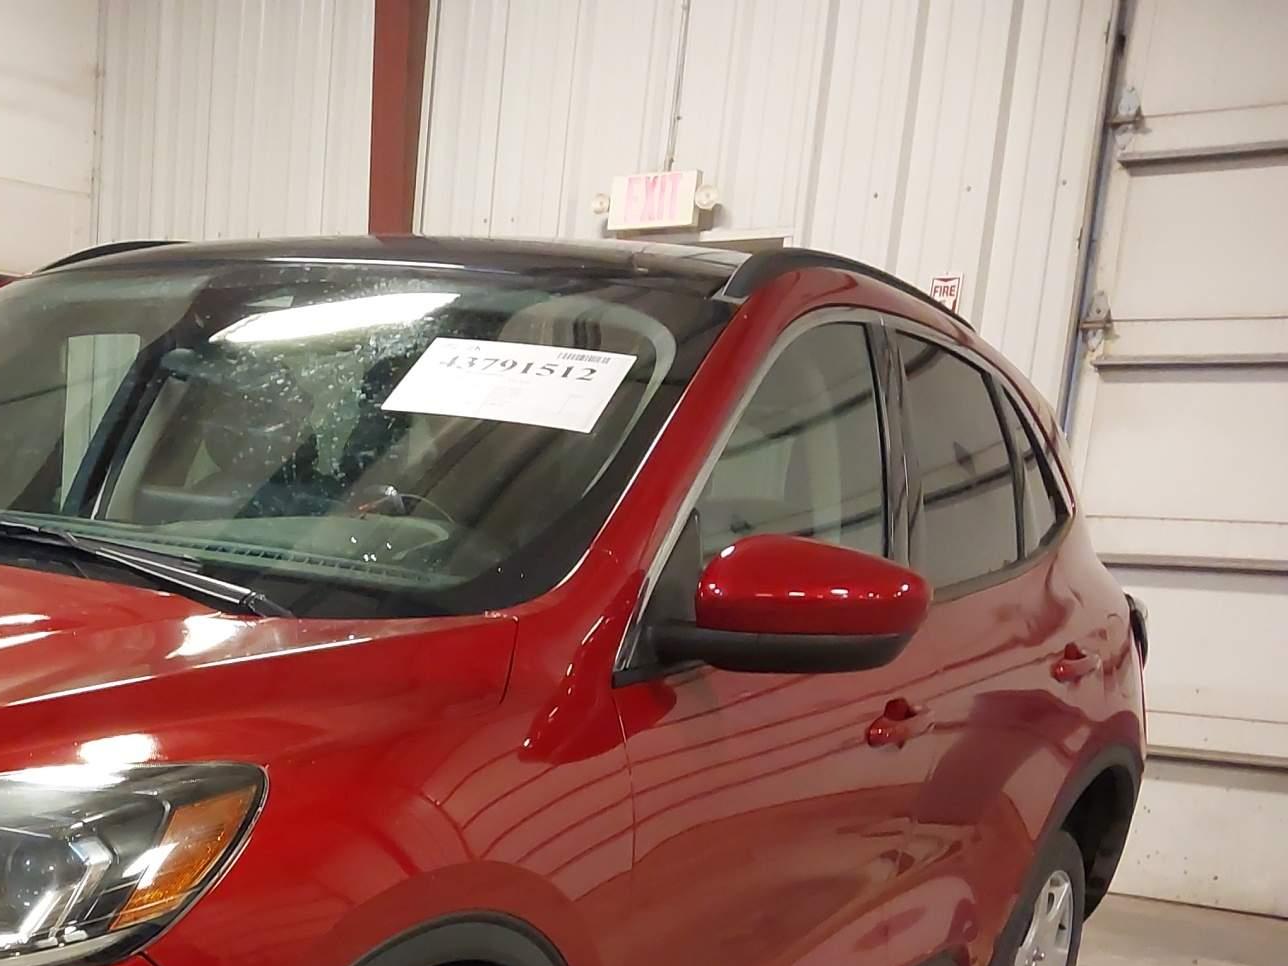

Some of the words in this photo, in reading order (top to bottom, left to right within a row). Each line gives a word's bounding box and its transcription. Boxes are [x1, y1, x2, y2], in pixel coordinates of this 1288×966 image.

[623, 172, 681, 222] EXIT
[933, 285, 956, 297] FIRE
[439, 355, 598, 382] 43791512
